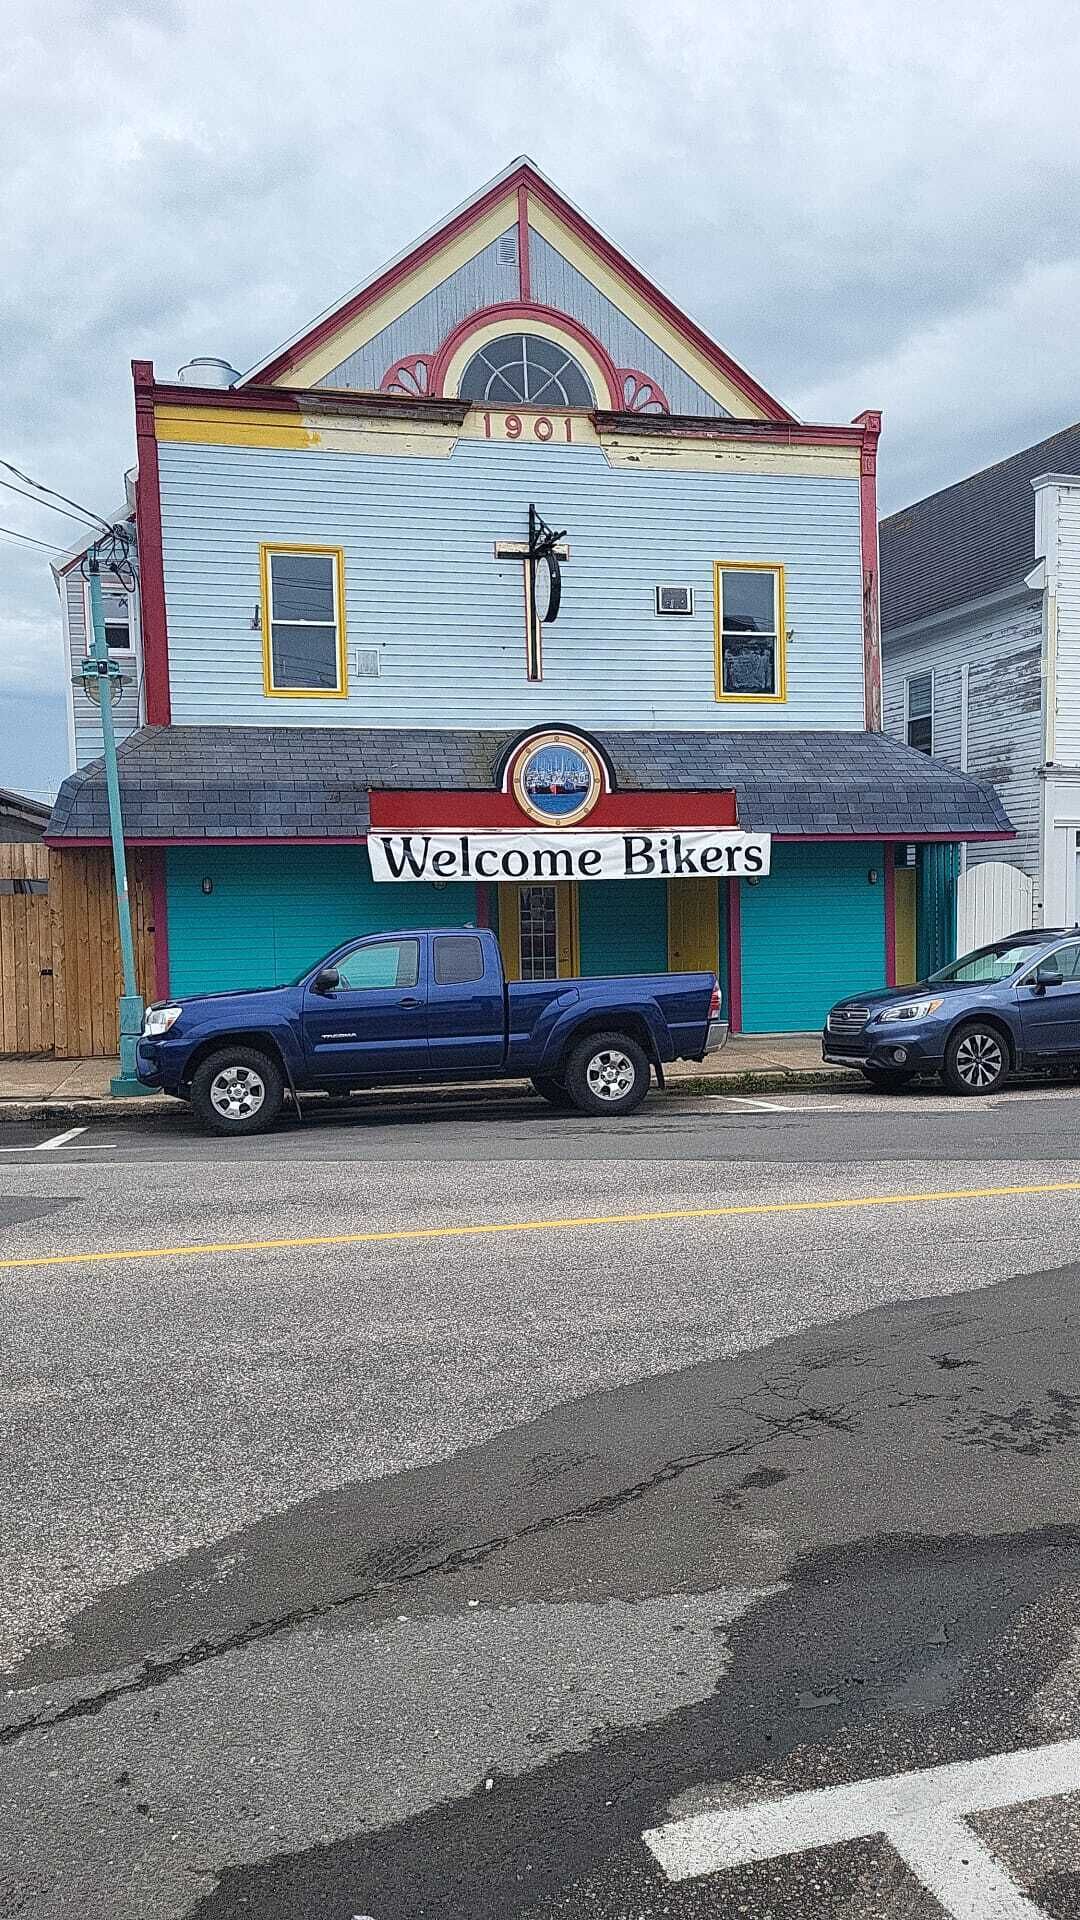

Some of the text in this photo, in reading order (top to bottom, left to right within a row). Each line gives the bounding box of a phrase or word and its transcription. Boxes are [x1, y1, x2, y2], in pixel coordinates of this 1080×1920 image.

[484, 413, 572, 442] 1901
[381, 835, 763, 878] Welcome Bikers
